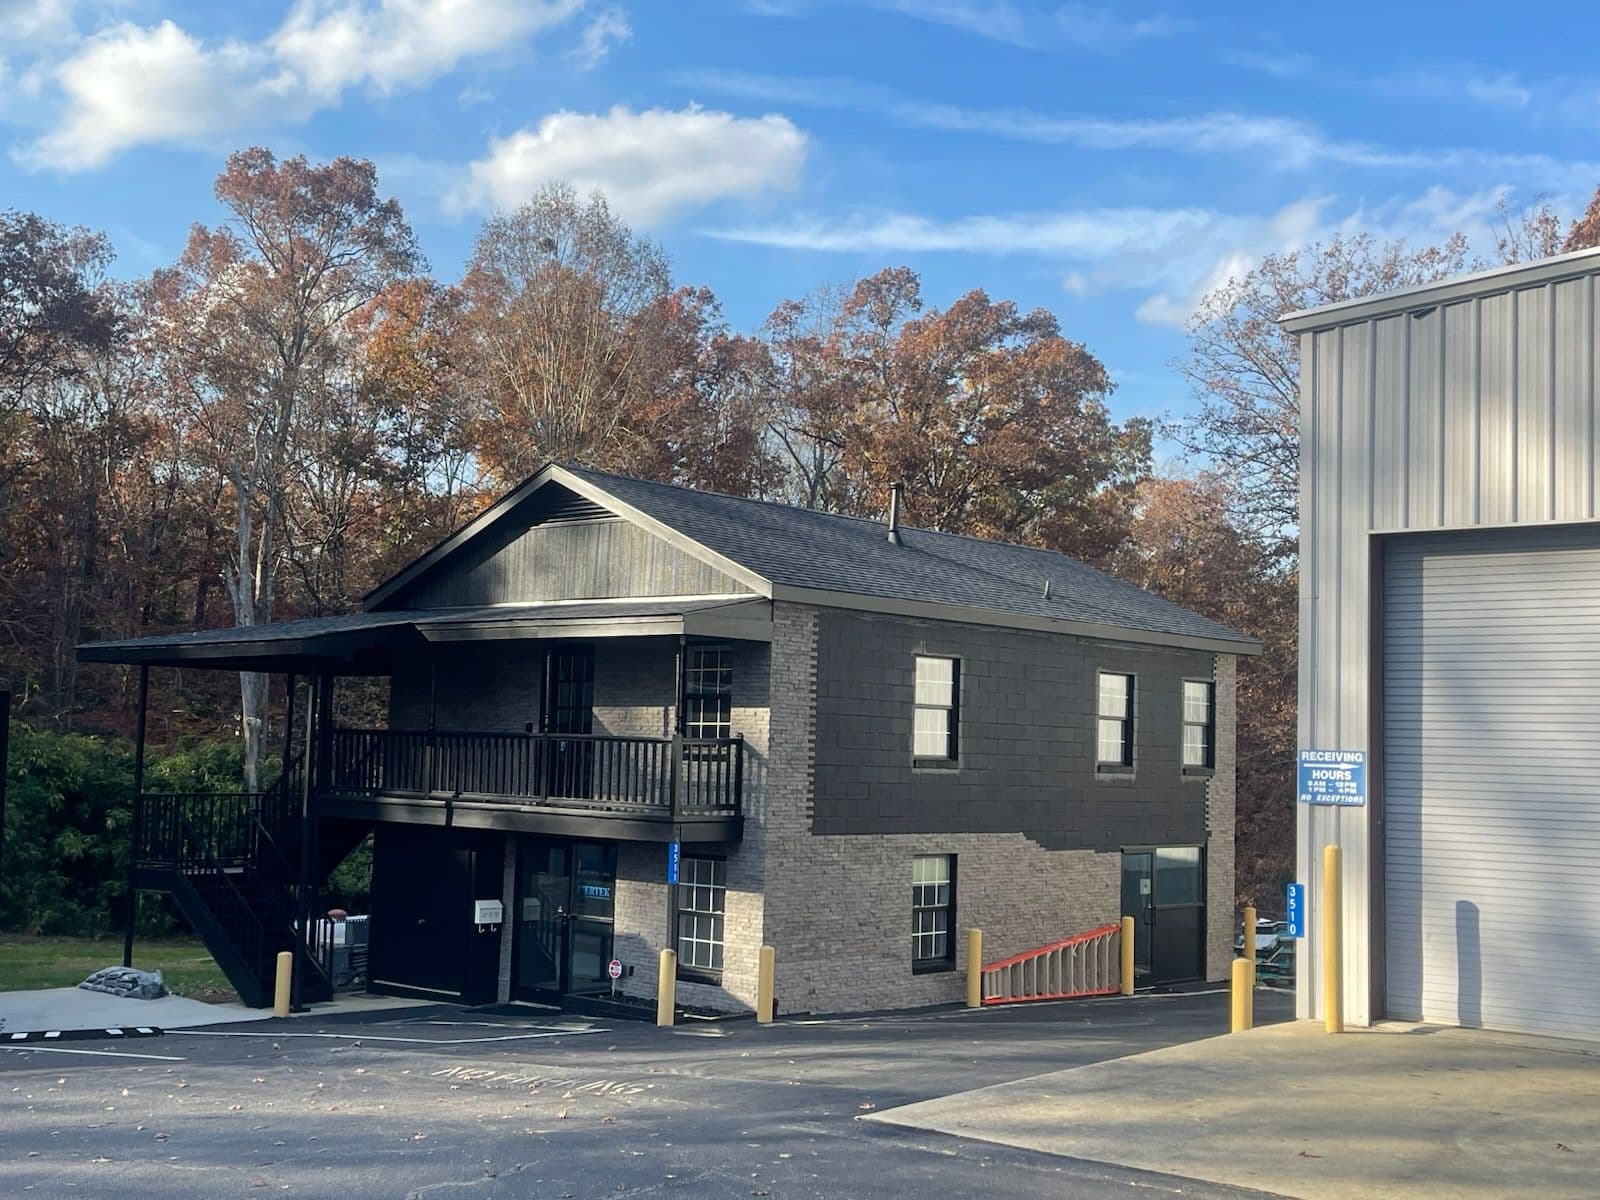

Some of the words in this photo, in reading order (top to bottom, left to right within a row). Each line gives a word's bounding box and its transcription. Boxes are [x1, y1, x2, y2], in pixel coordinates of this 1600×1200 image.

[1302, 751, 1363, 762] RECEIVING
[1312, 769, 1352, 780] HOURS
[1300, 793, 1312, 801] NO
[1316, 794, 1364, 803] EXCEPTIONS
